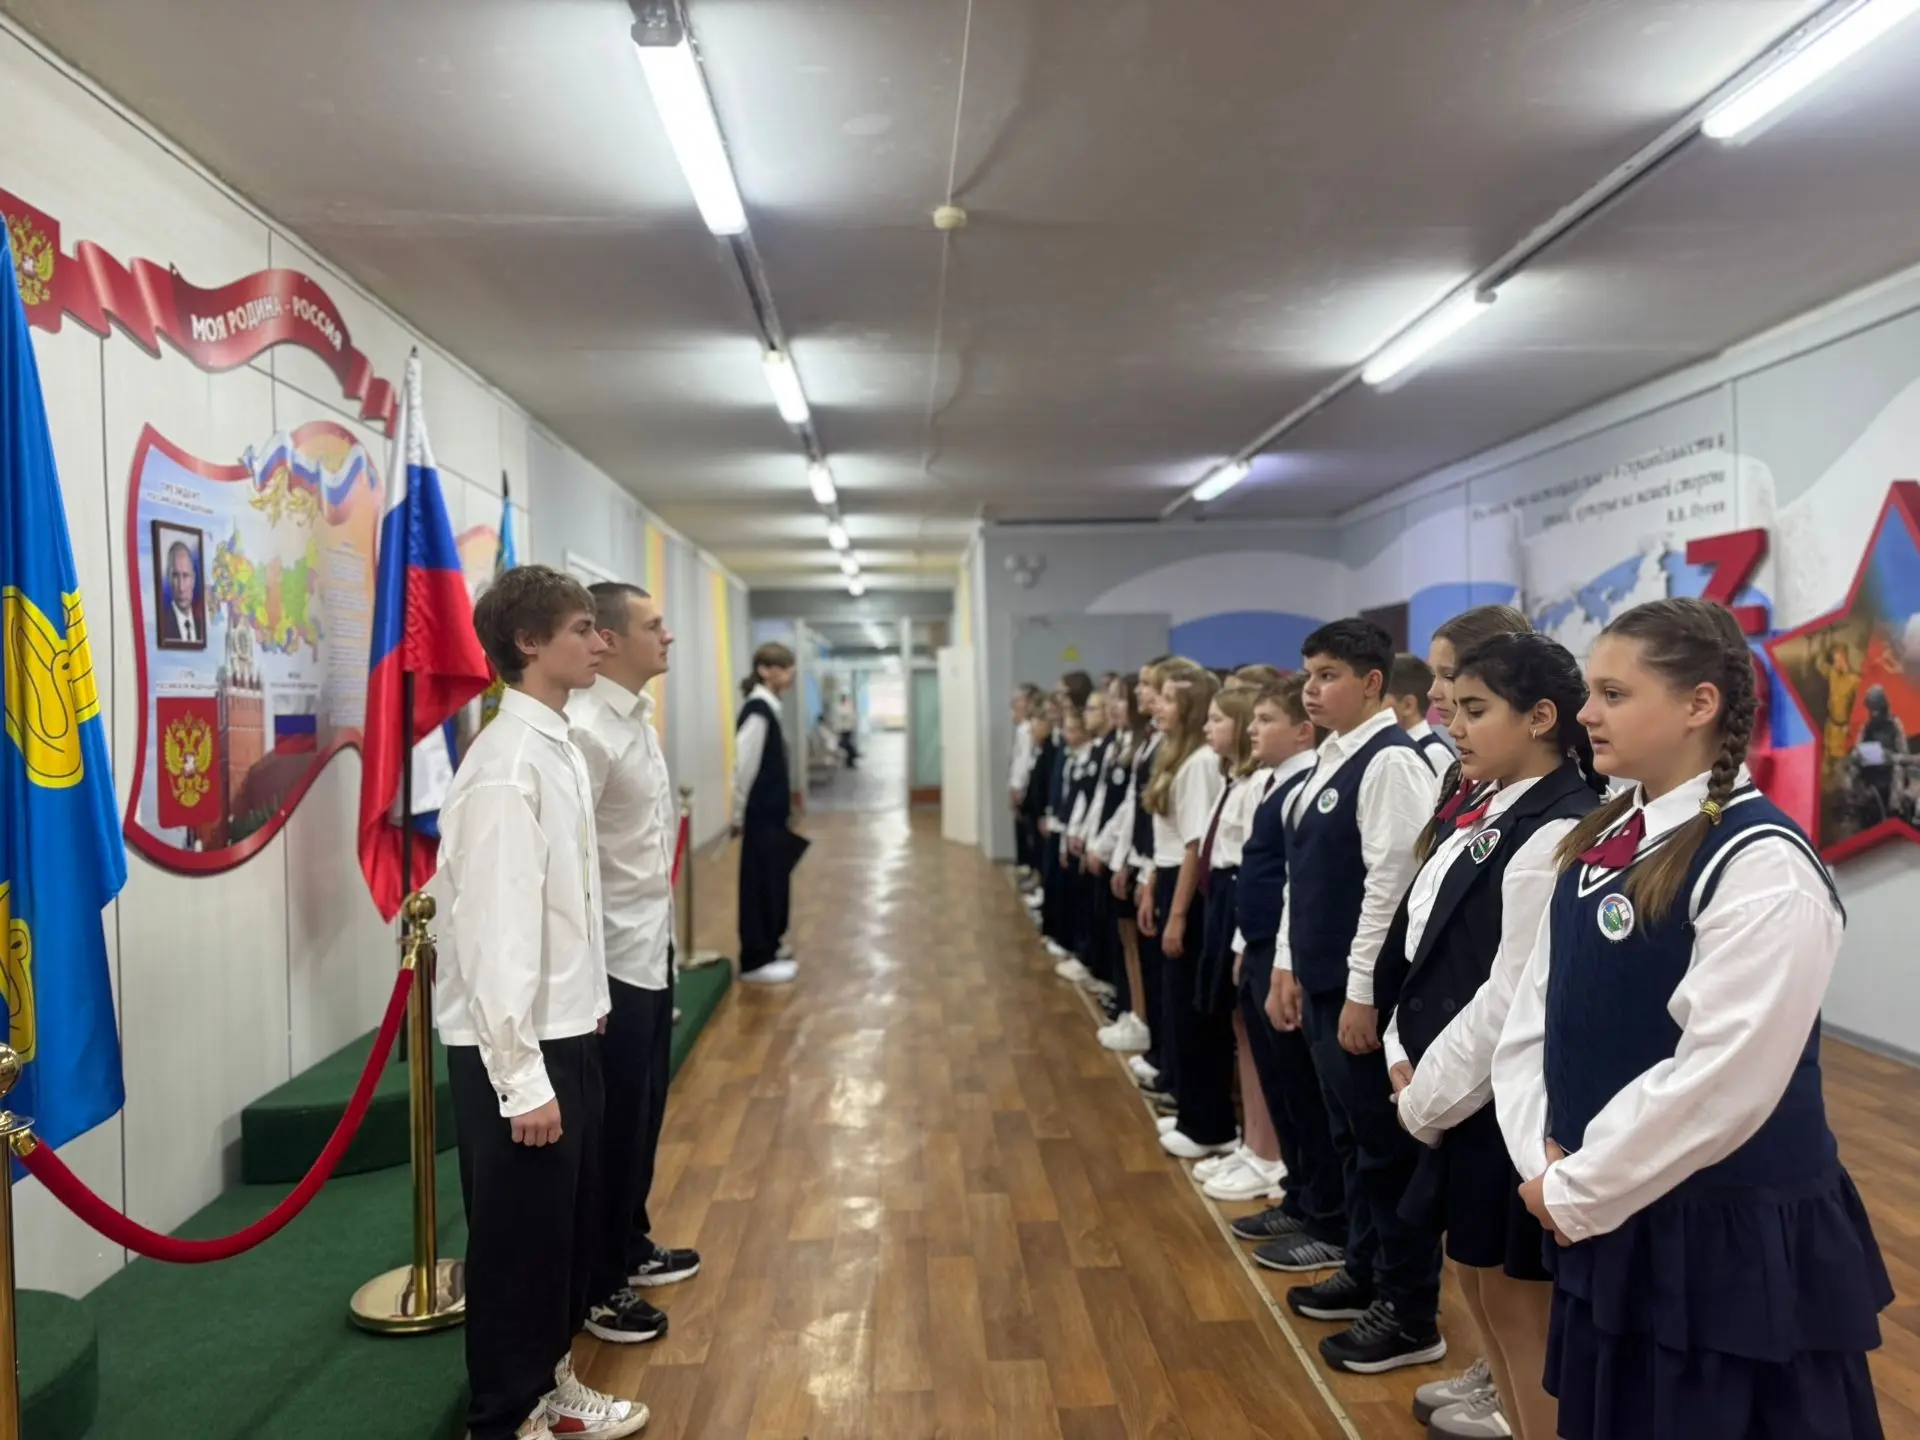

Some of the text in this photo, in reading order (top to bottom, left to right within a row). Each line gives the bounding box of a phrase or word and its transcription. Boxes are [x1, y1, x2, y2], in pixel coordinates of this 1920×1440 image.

[190, 313, 228, 342] МОЯ
[226, 296, 283, 335] РОДИНА
[292, 295, 343, 352] РОССИЯ
